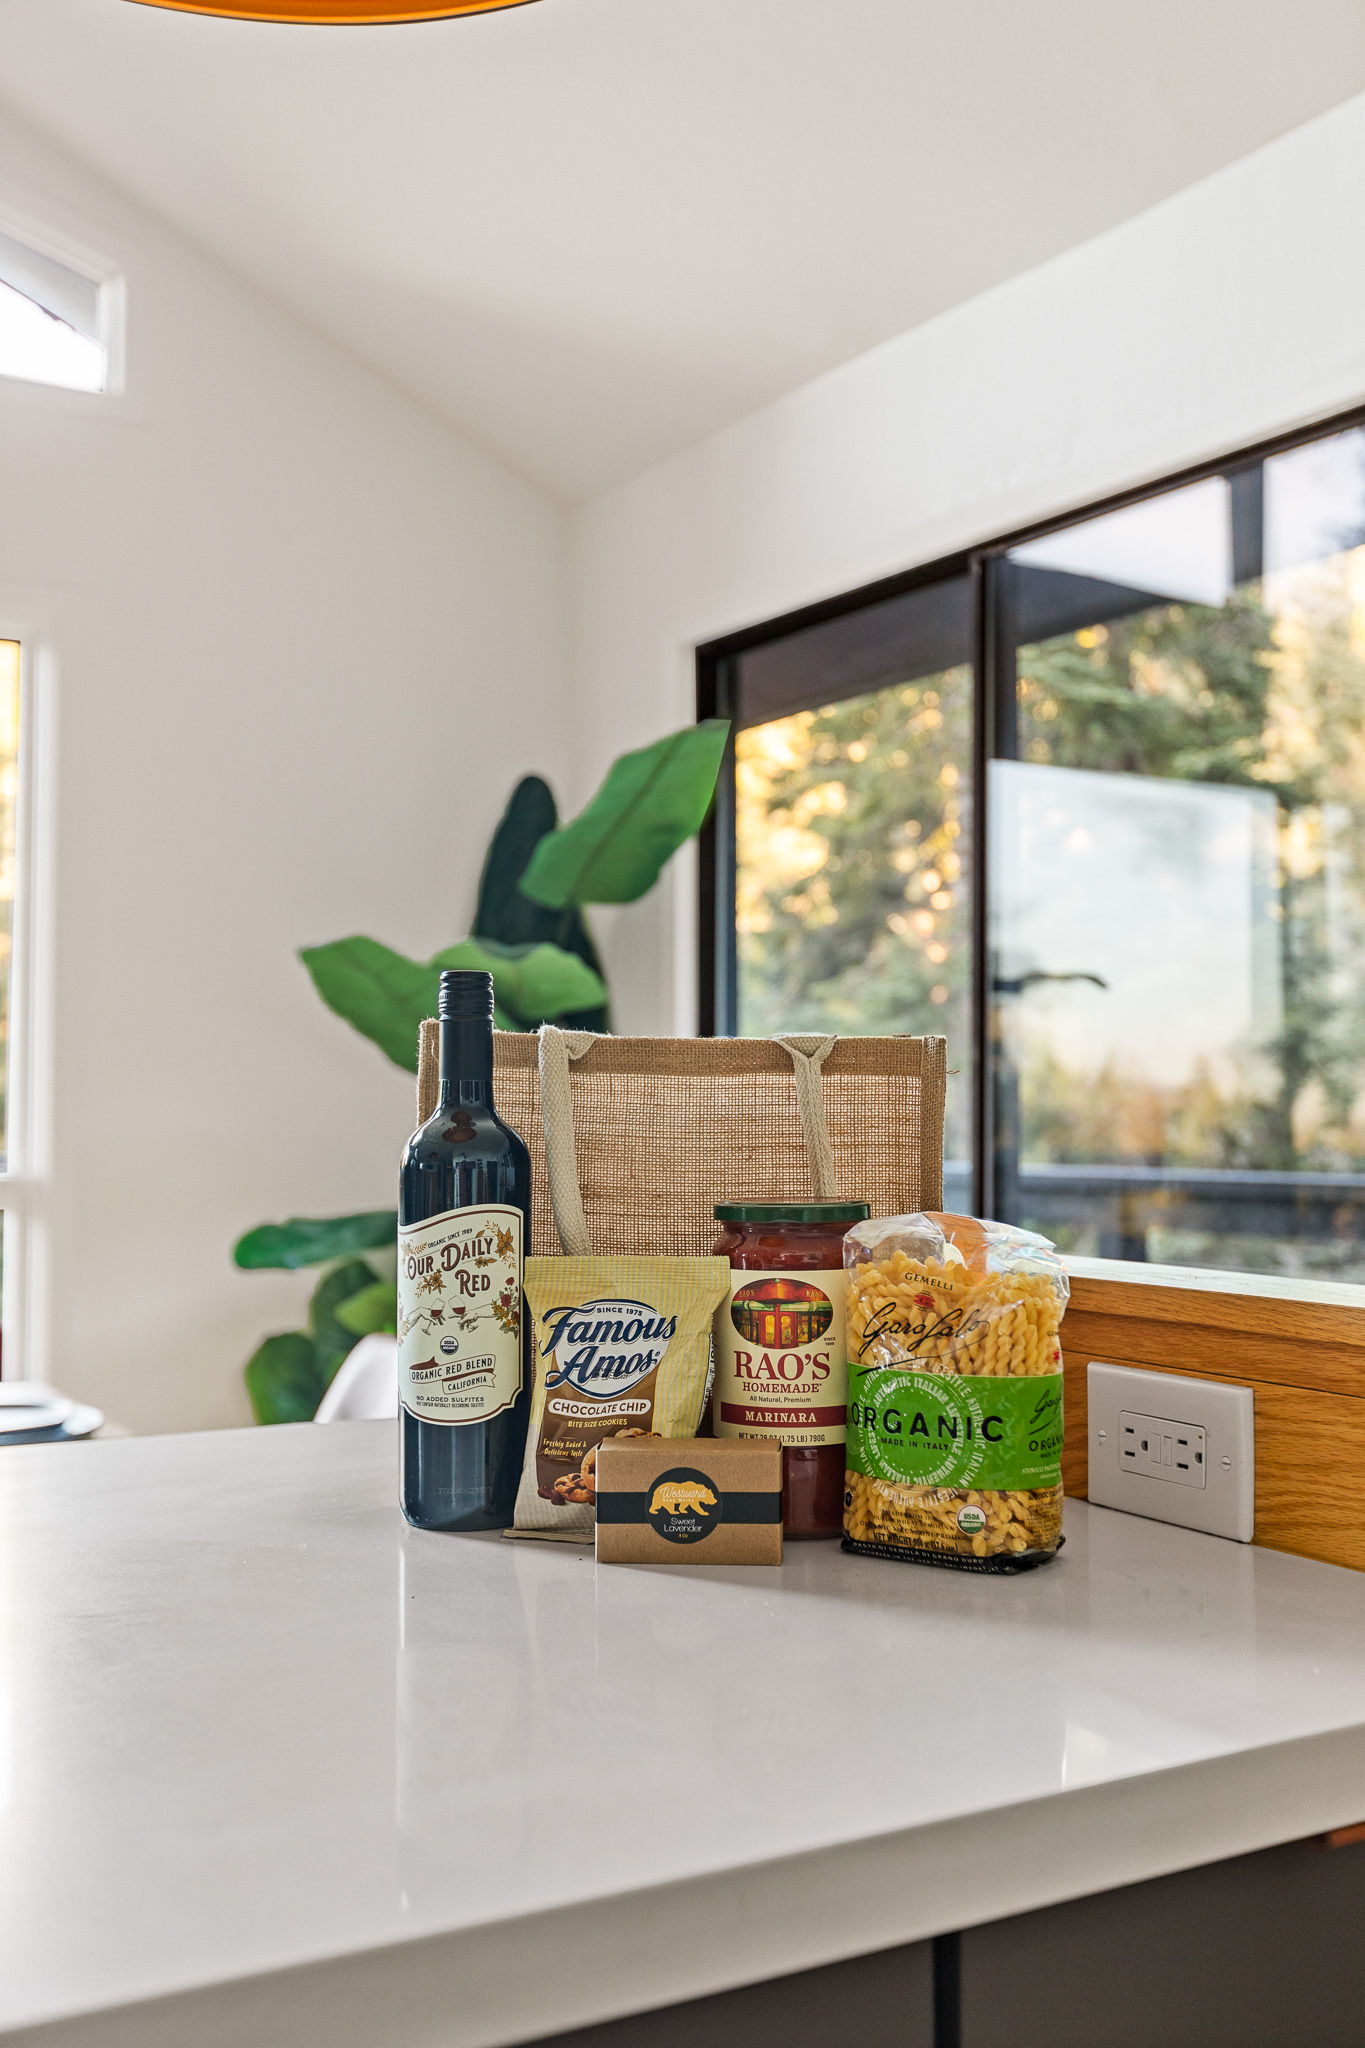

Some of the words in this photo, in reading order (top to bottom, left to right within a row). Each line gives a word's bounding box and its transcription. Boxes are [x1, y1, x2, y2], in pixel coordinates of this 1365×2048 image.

[428, 1237, 446, 1249] ORGANIC
[447, 1231, 460, 1241] SINCE
[408, 1256, 434, 1280] OUR
[440, 1238, 494, 1271] DAILY
[455, 1269, 491, 1298] RED
[905, 1272, 953, 1291] GEMELLI
[626, 1308, 642, 1316] 1975
[540, 1306, 679, 1358] Famous
[857, 1302, 990, 1362] Garofalo
[411, 1369, 442, 1380] ORGANIC
[446, 1364, 462, 1375] RED
[466, 1358, 493, 1370] BLEND
[545, 1346, 658, 1388] Amos
[734, 1351, 831, 1381] RAO'S
[448, 1376, 487, 1391] CALIFORNIA
[742, 1382, 821, 1394] HOMEMADE
[759, 1396, 783, 1404] Natural,
[552, 1402, 618, 1416] CHOCOLATE
[620, 1402, 647, 1412] CHIP
[567, 1420, 583, 1428] BITE
[583, 1420, 597, 1428] SIZE
[598, 1418, 628, 1427] COOKIES
[745, 1411, 817, 1423] MARINARA
[851, 1402, 1004, 1442] ORGANIC
[543, 1438, 564, 1449] Freshly
[780, 1434, 795, 1443] (1.75
[796, 1435, 808, 1443] LB)
[880, 1437, 904, 1447] MADE
[909, 1440, 918, 1448] IN
[923, 1442, 949, 1452] ITALY
[544, 1447, 569, 1457] Delicious
[660, 1486, 707, 1499] Westward
[670, 1517, 696, 1526] Sweet
[963, 1513, 980, 1521] USDA
[663, 1524, 702, 1533] Lavender
[873, 1531, 886, 1543] NET
[886, 1533, 912, 1546] WEIGHT
[853, 1541, 877, 1550] PASTA
[888, 1546, 920, 1556] SEMOLA
[932, 1553, 959, 1562] GRANO
